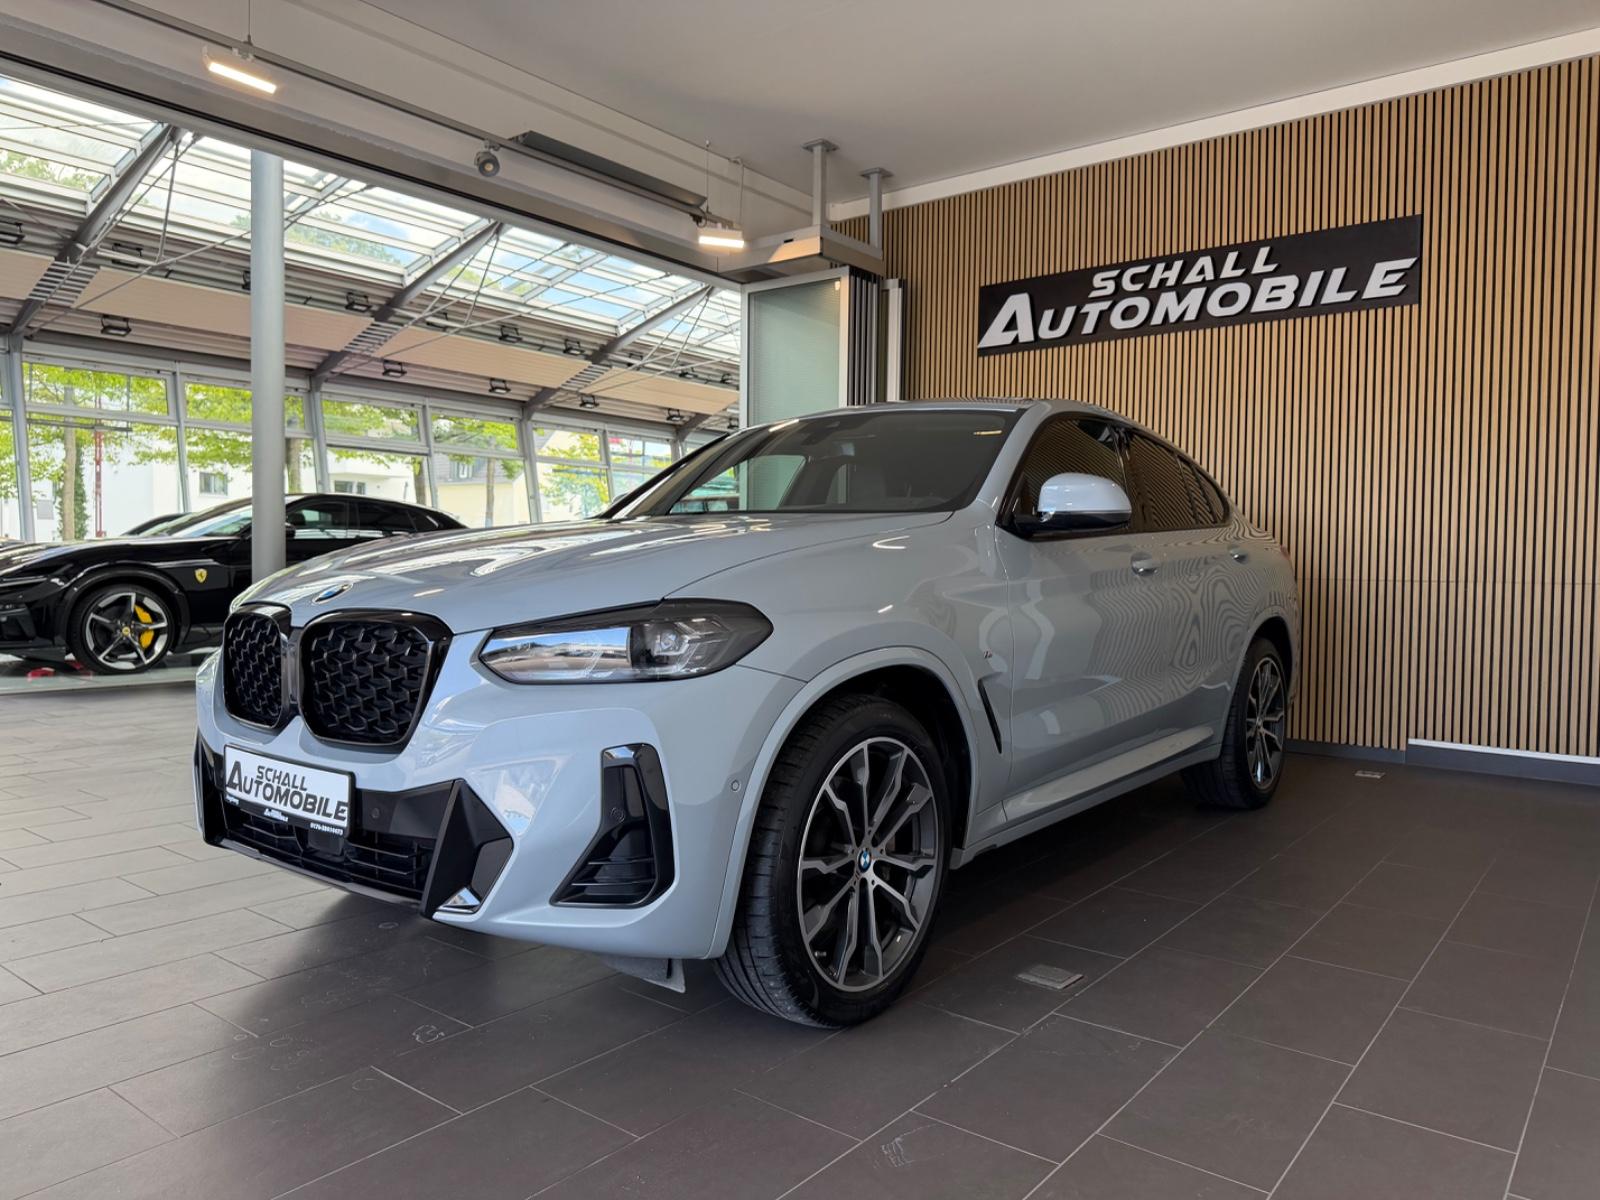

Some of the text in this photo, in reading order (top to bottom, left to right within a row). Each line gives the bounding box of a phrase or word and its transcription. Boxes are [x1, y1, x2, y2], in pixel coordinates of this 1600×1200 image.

[1089, 246, 1280, 297] SCHALL
[977, 257, 1418, 349] AUTOMOBILE
[226, 761, 349, 821] AUTOMOBILE
[257, 765, 307, 791] SCHALL
